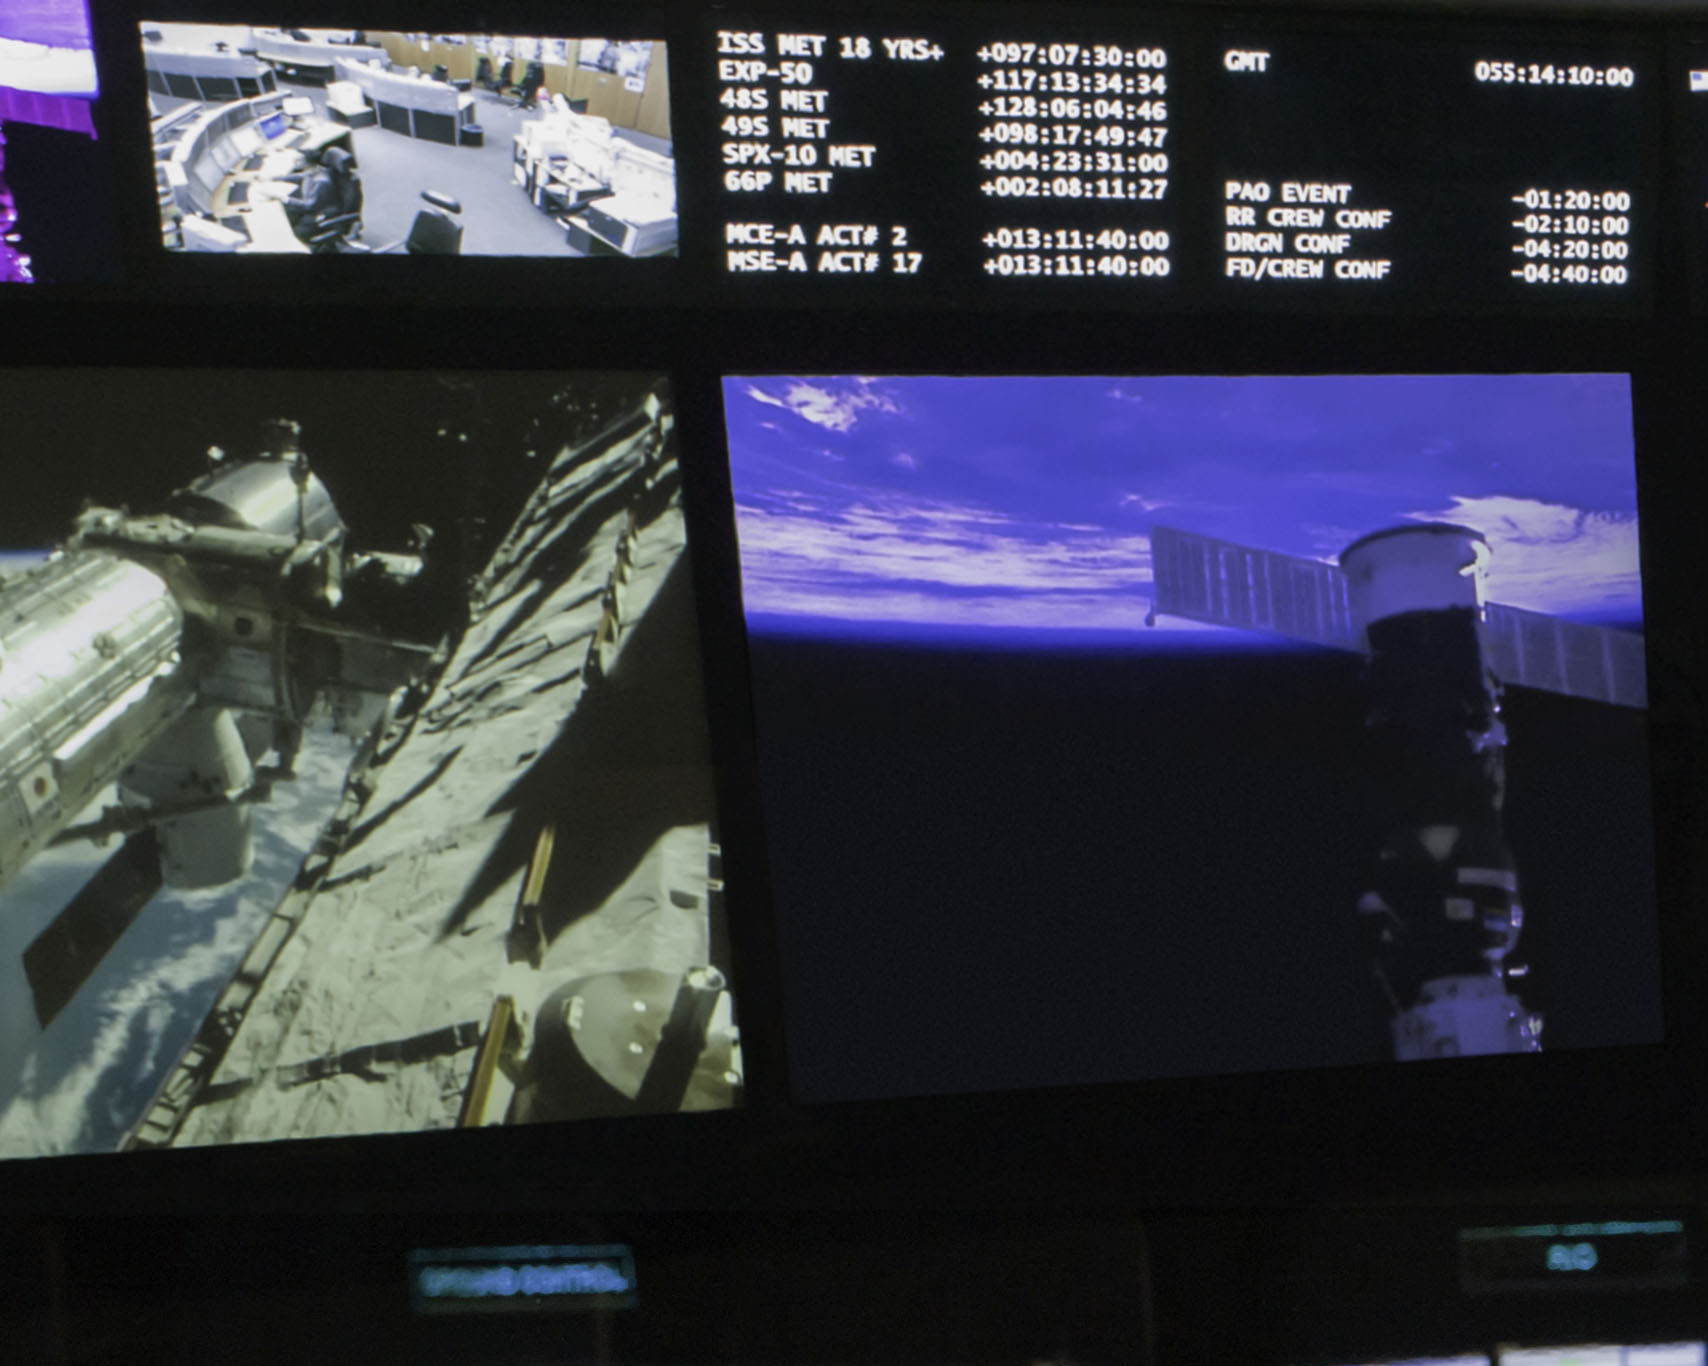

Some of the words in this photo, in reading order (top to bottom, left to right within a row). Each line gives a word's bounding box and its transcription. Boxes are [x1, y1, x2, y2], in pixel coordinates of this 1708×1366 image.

[718, 31, 764, 54] ISS
[777, 34, 826, 57] MET
[839, 37, 871, 59] 18
[884, 39, 944, 61] YRS+
[977, 43, 1166, 69] +097:07:30:00
[719, 61, 812, 85] EXP-50
[977, 72, 1166, 95] +117:13:34:34
[1224, 51, 1270, 72] GMT
[1475, 62, 1634, 87] 055:14:10:00
[720, 89, 768, 110] 48S
[780, 91, 828, 112] MET
[978, 98, 1167, 120] +128:06:04:46
[721, 117, 769, 137] 49S
[781, 119, 829, 139] MET
[979, 124, 1167, 147] +098:17:49:47
[722, 145, 816, 166] SPX-10
[828, 146, 876, 167] MET
[980, 152, 1168, 173] +004:23:31:00
[724, 172, 773, 191] 66P
[784, 173, 832, 193] MET
[980, 178, 1167, 199] +002:08:11:27
[1226, 181, 1270, 201] PAO
[1282, 183, 1351, 204] EVENT
[1512, 189, 1630, 212] -01:20:00
[1226, 207, 1255, 227] RR
[1267, 208, 1323, 228] CREW
[1335, 210, 1391, 230] CONF
[1512, 216, 1629, 236] -02:10:00
[726, 223, 805, 246] MCE-A
[817, 225, 878, 246] ACT#
[892, 227, 906, 246] 2
[983, 229, 1168, 251] +013:11:40:00
[1226, 233, 1283, 253] DRGN
[1295, 234, 1350, 255] CONF
[1512, 241, 1628, 261] -04:20:00
[727, 252, 806, 272] MSE-A
[818, 253, 879, 273] ACT#
[893, 253, 922, 273] 17
[984, 255, 1169, 277] +013:11:40:00
[1226, 259, 1323, 280] FD/CREW
[1335, 261, 1391, 279] CONF
[1512, 264, 1628, 284] -04:40:00
